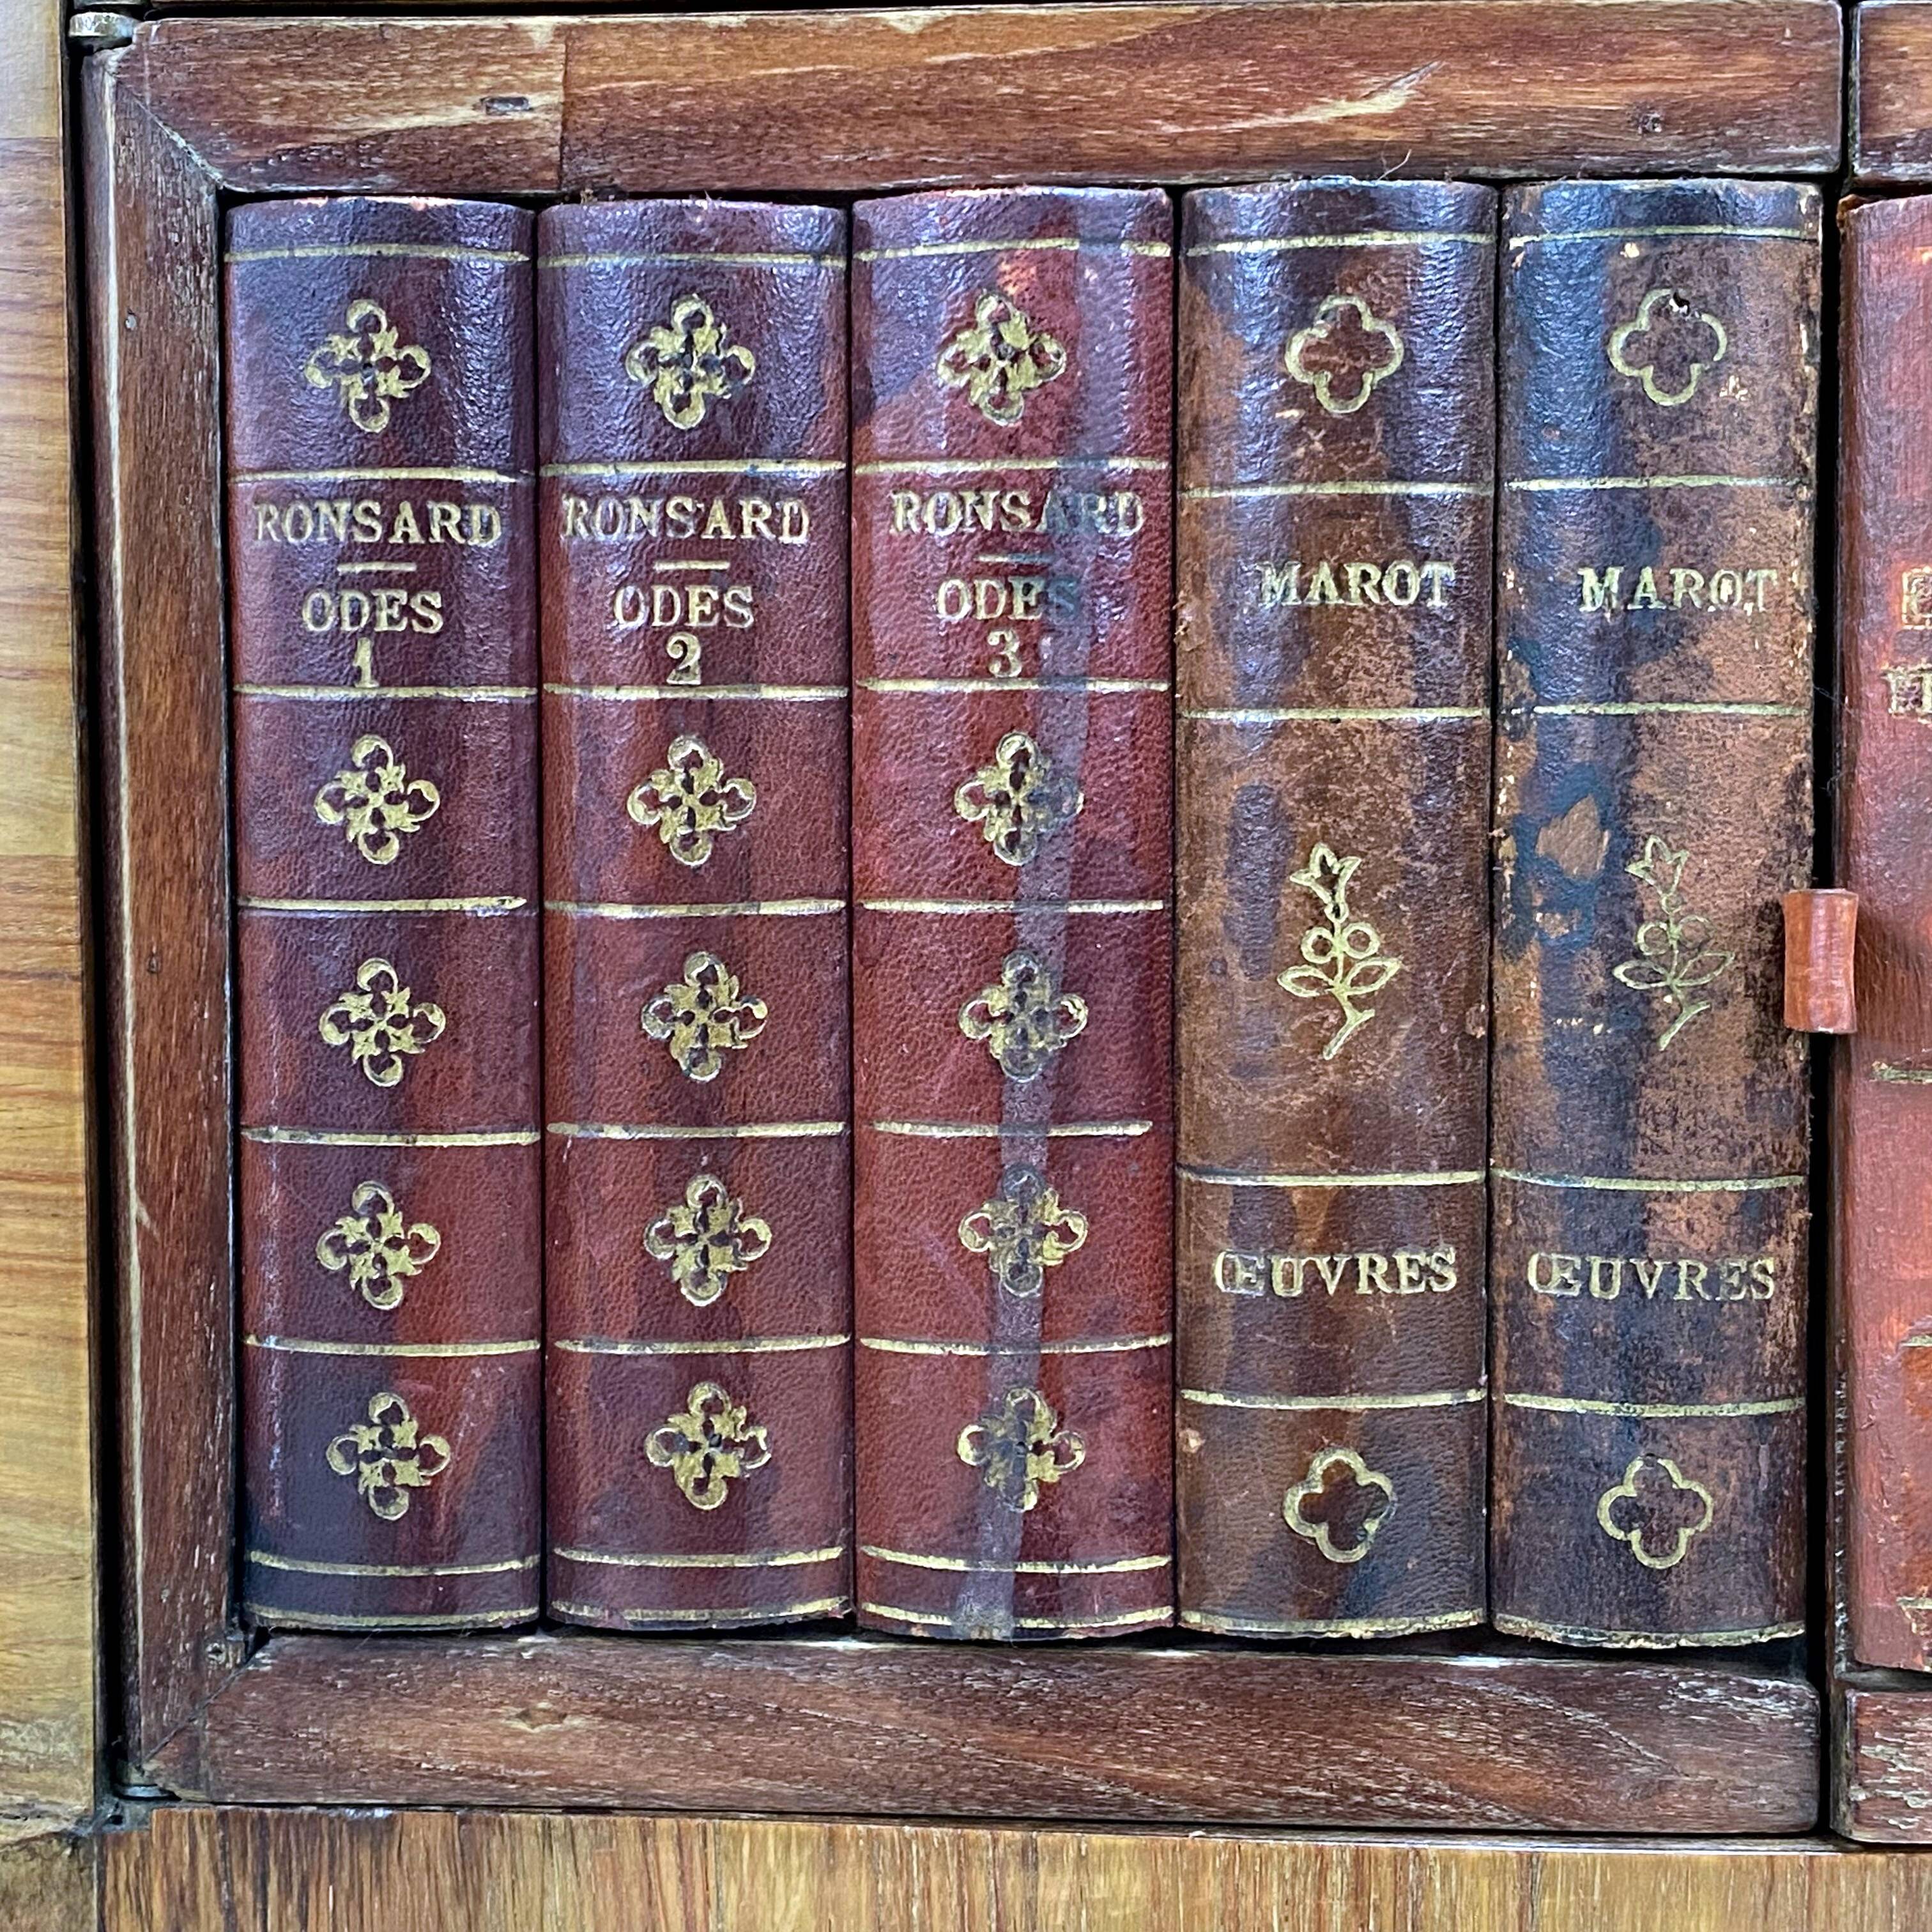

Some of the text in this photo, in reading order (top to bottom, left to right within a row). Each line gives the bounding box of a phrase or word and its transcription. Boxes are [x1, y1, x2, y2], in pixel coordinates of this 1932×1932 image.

[254, 499, 502, 547] RONSARD
[561, 494, 810, 545] RONSARD
[612, 585, 755, 629] ODES
[936, 576, 1082, 624] ODES
[1255, 560, 1456, 608] MAROT
[1577, 565, 1779, 614] MAROT
[302, 588, 444, 634] ODES
[352, 636, 379, 688] 1
[666, 632, 702, 686] 2
[986, 628, 1023, 678] 3
